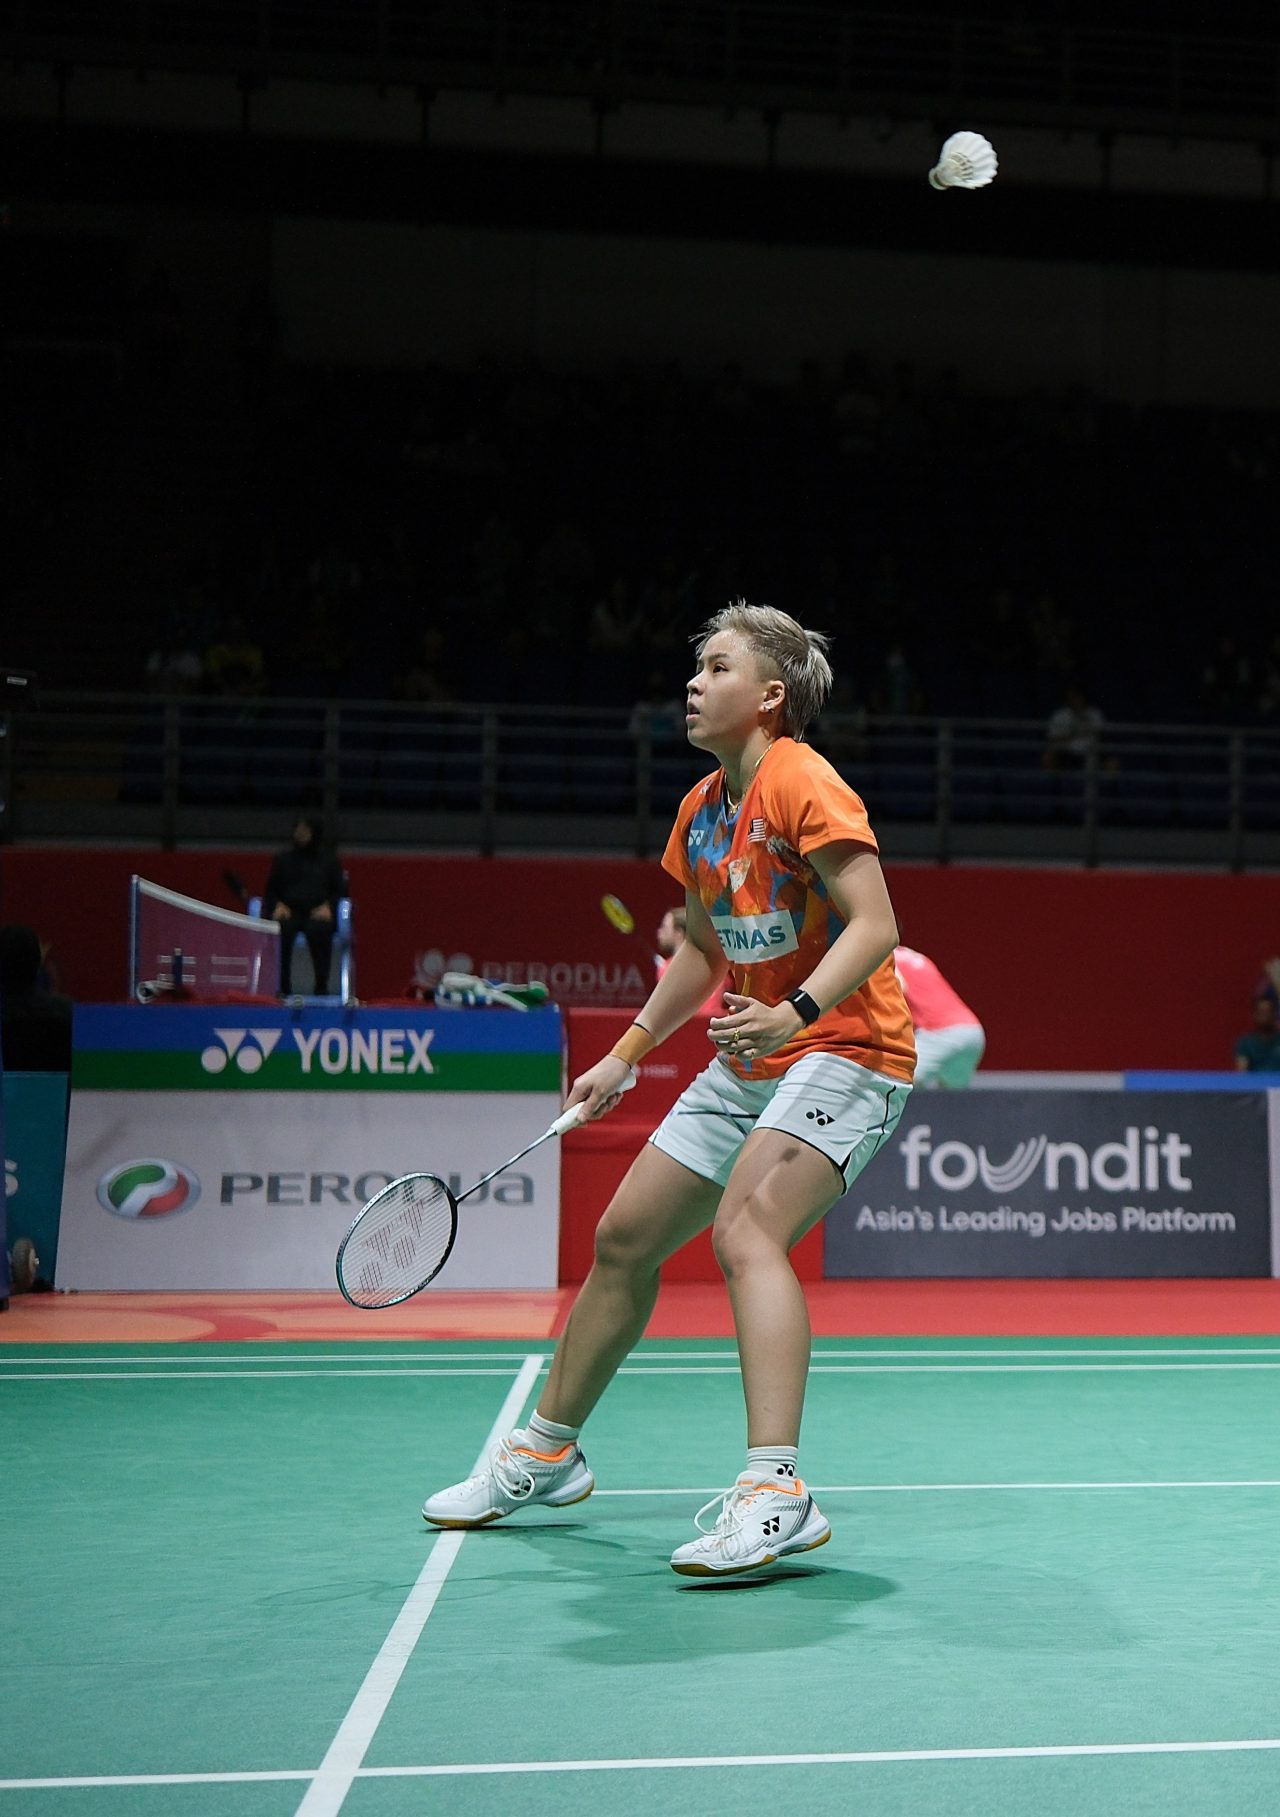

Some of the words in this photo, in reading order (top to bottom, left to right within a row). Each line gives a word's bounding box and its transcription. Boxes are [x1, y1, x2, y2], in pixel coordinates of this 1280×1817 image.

[292, 1028, 434, 1074] YONEX
[900, 1124, 1193, 1193] foundit
[856, 1206, 934, 1232] Asia's
[939, 1206, 1046, 1237] Leading
[1050, 1206, 1117, 1232] Jobs
[1122, 1206, 1236, 1232] Platform
